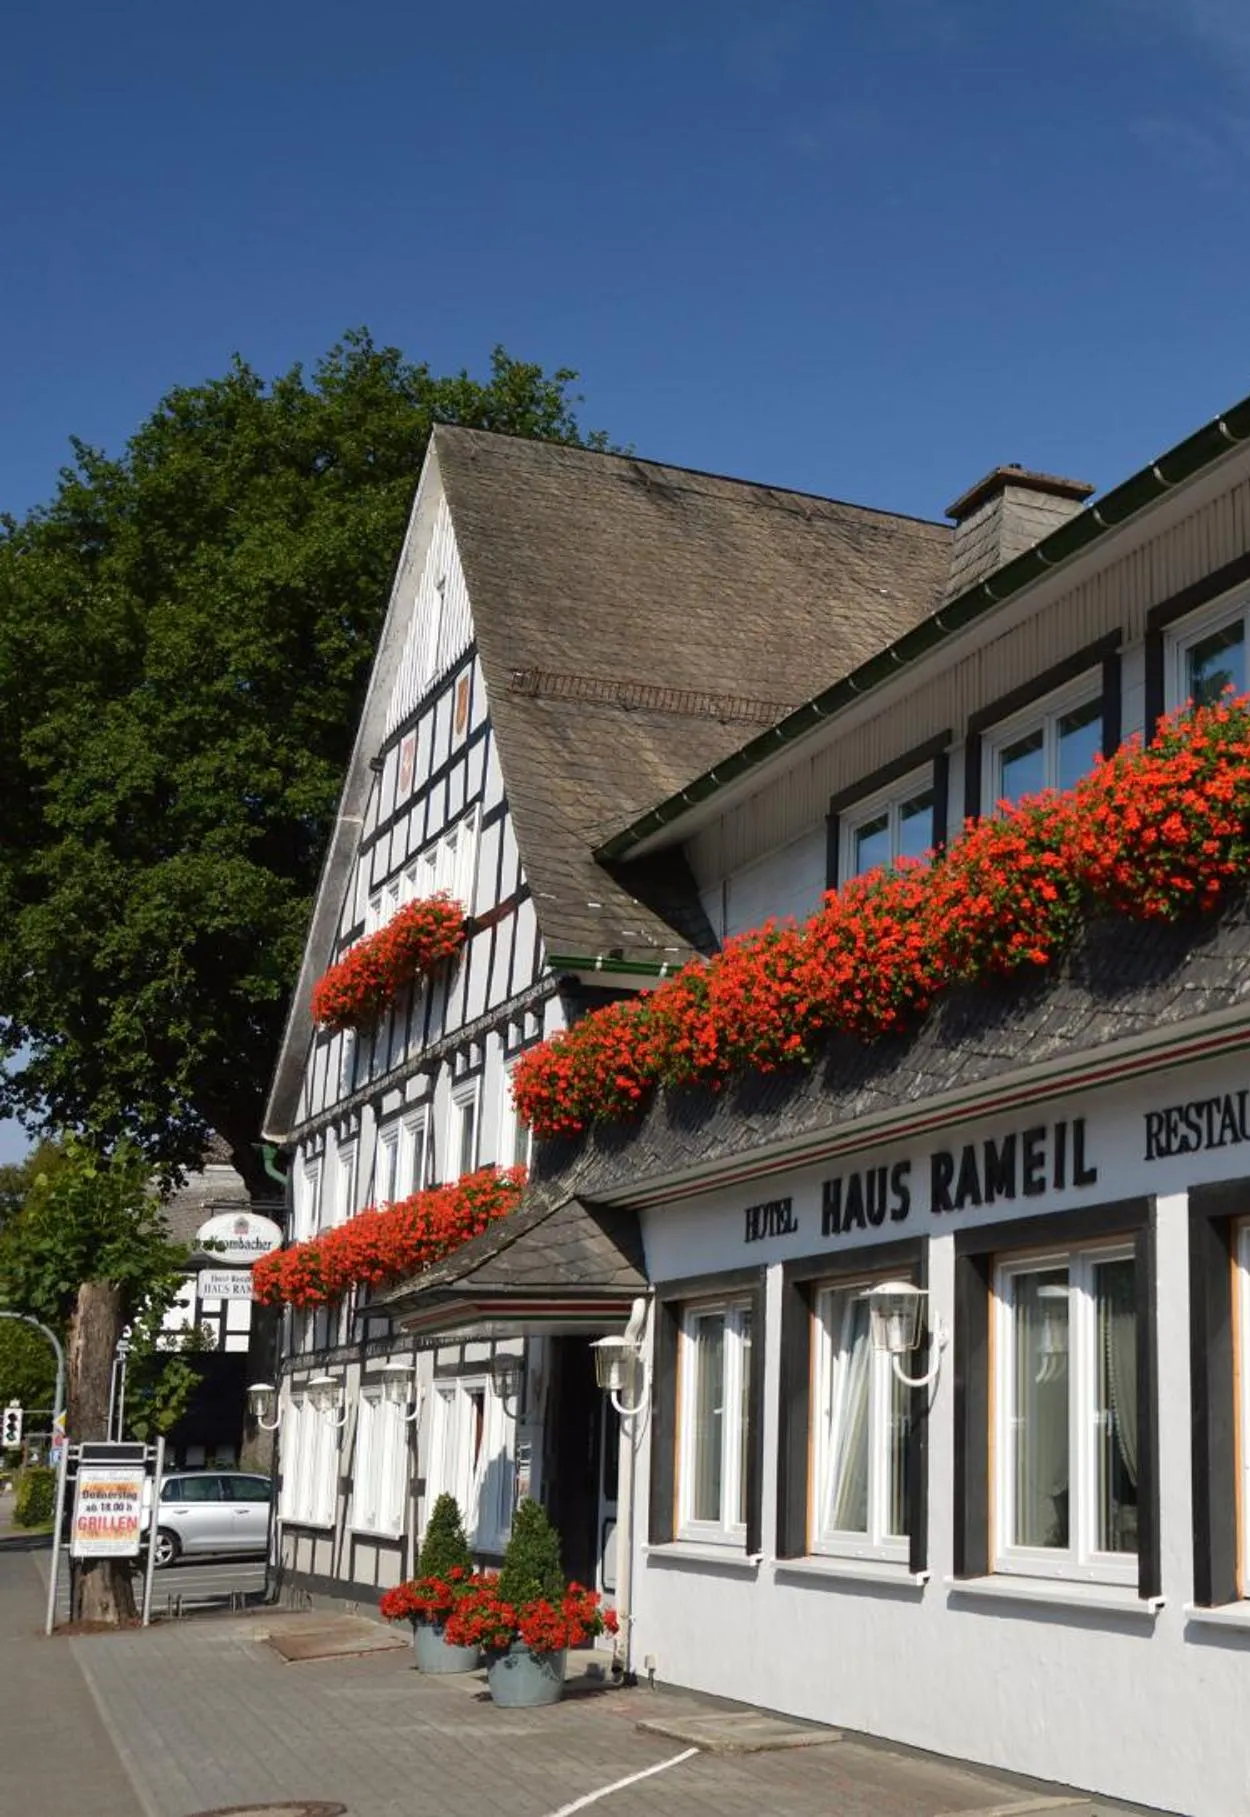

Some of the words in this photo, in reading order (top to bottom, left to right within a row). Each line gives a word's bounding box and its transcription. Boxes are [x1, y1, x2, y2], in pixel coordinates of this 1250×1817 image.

[744, 1197, 798, 1243] HOTEL
[821, 1159, 911, 1236] HAUS
[930, 1117, 1097, 1213] RAMEIL
[82, 1490, 138, 1501] Donnerstag
[78, 1516, 137, 1532] GRILLEN
